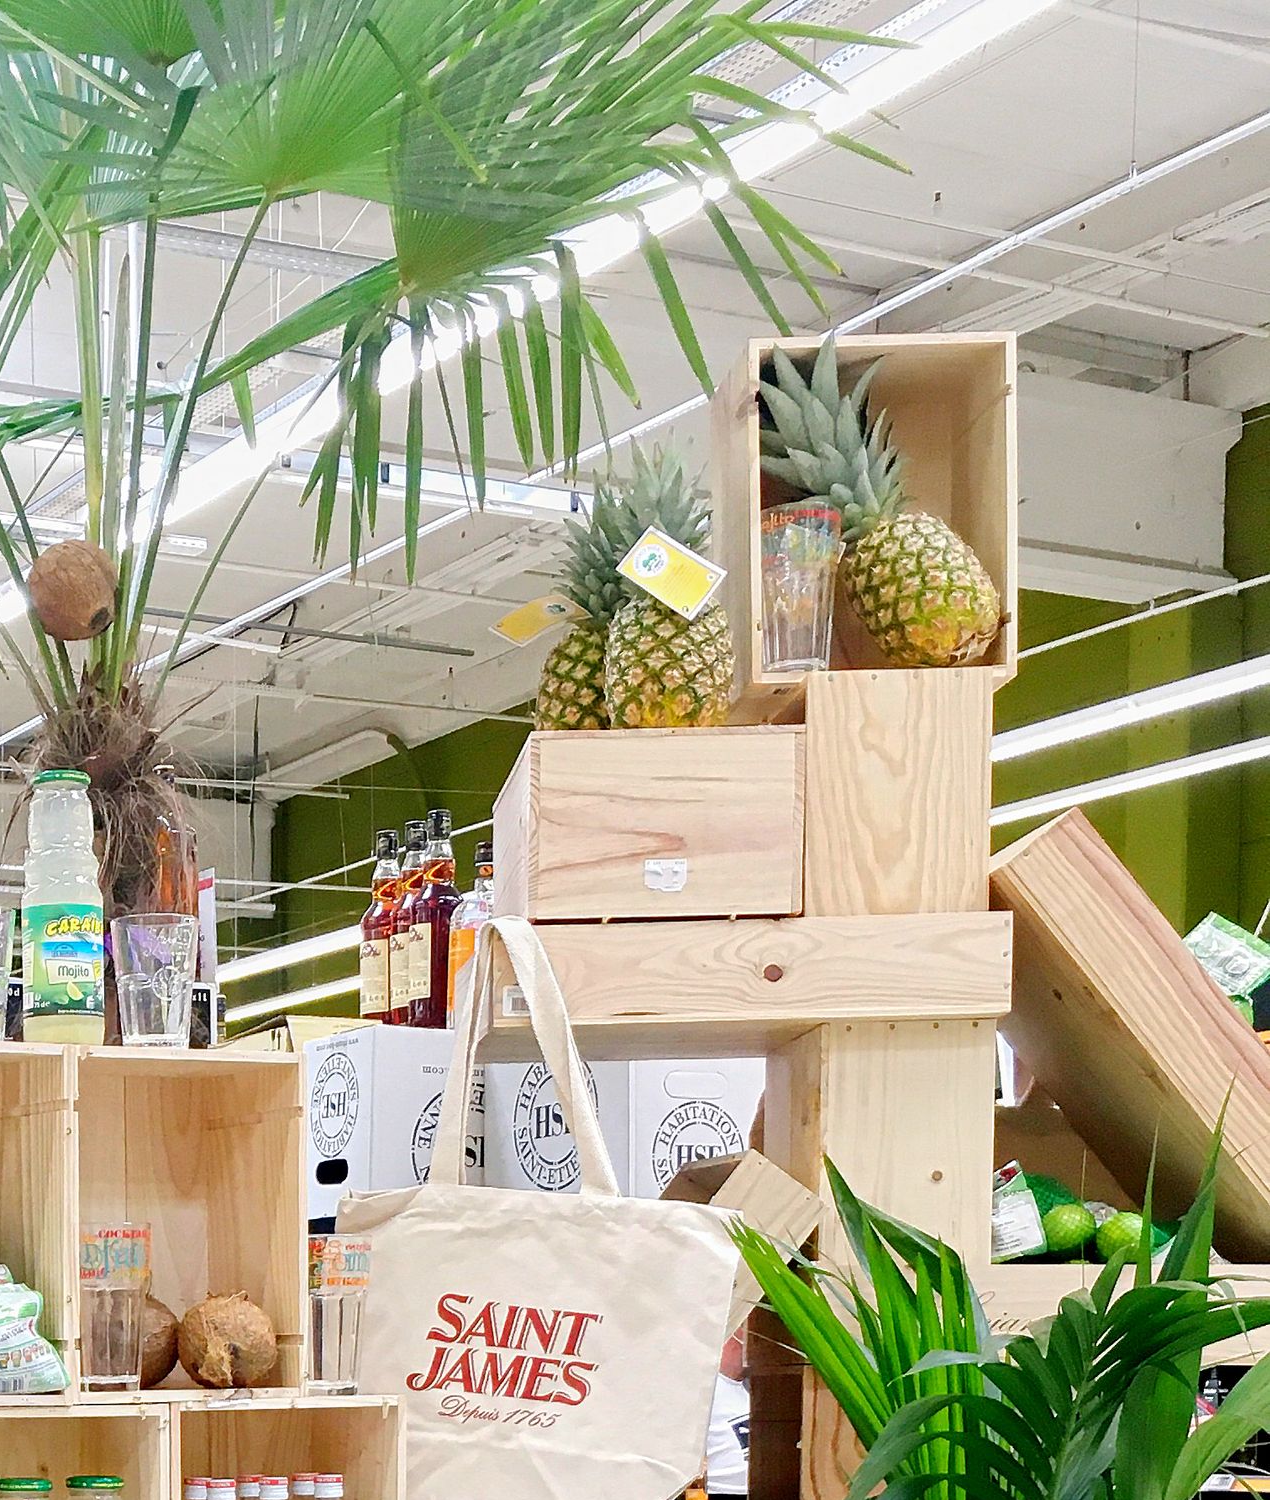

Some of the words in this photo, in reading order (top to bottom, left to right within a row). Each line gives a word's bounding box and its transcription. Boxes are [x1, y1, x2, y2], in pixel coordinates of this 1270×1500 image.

[57, 965, 89, 978] Mojito
[322, 1093, 346, 1120] HSE
[659, 1106, 739, 1147] HABITATION
[426, 1293, 604, 1357] SAINT
[405, 1346, 600, 1407] JAMES
[436, 1395, 499, 1423] Depuis
[501, 1407, 563, 1429] 1765
